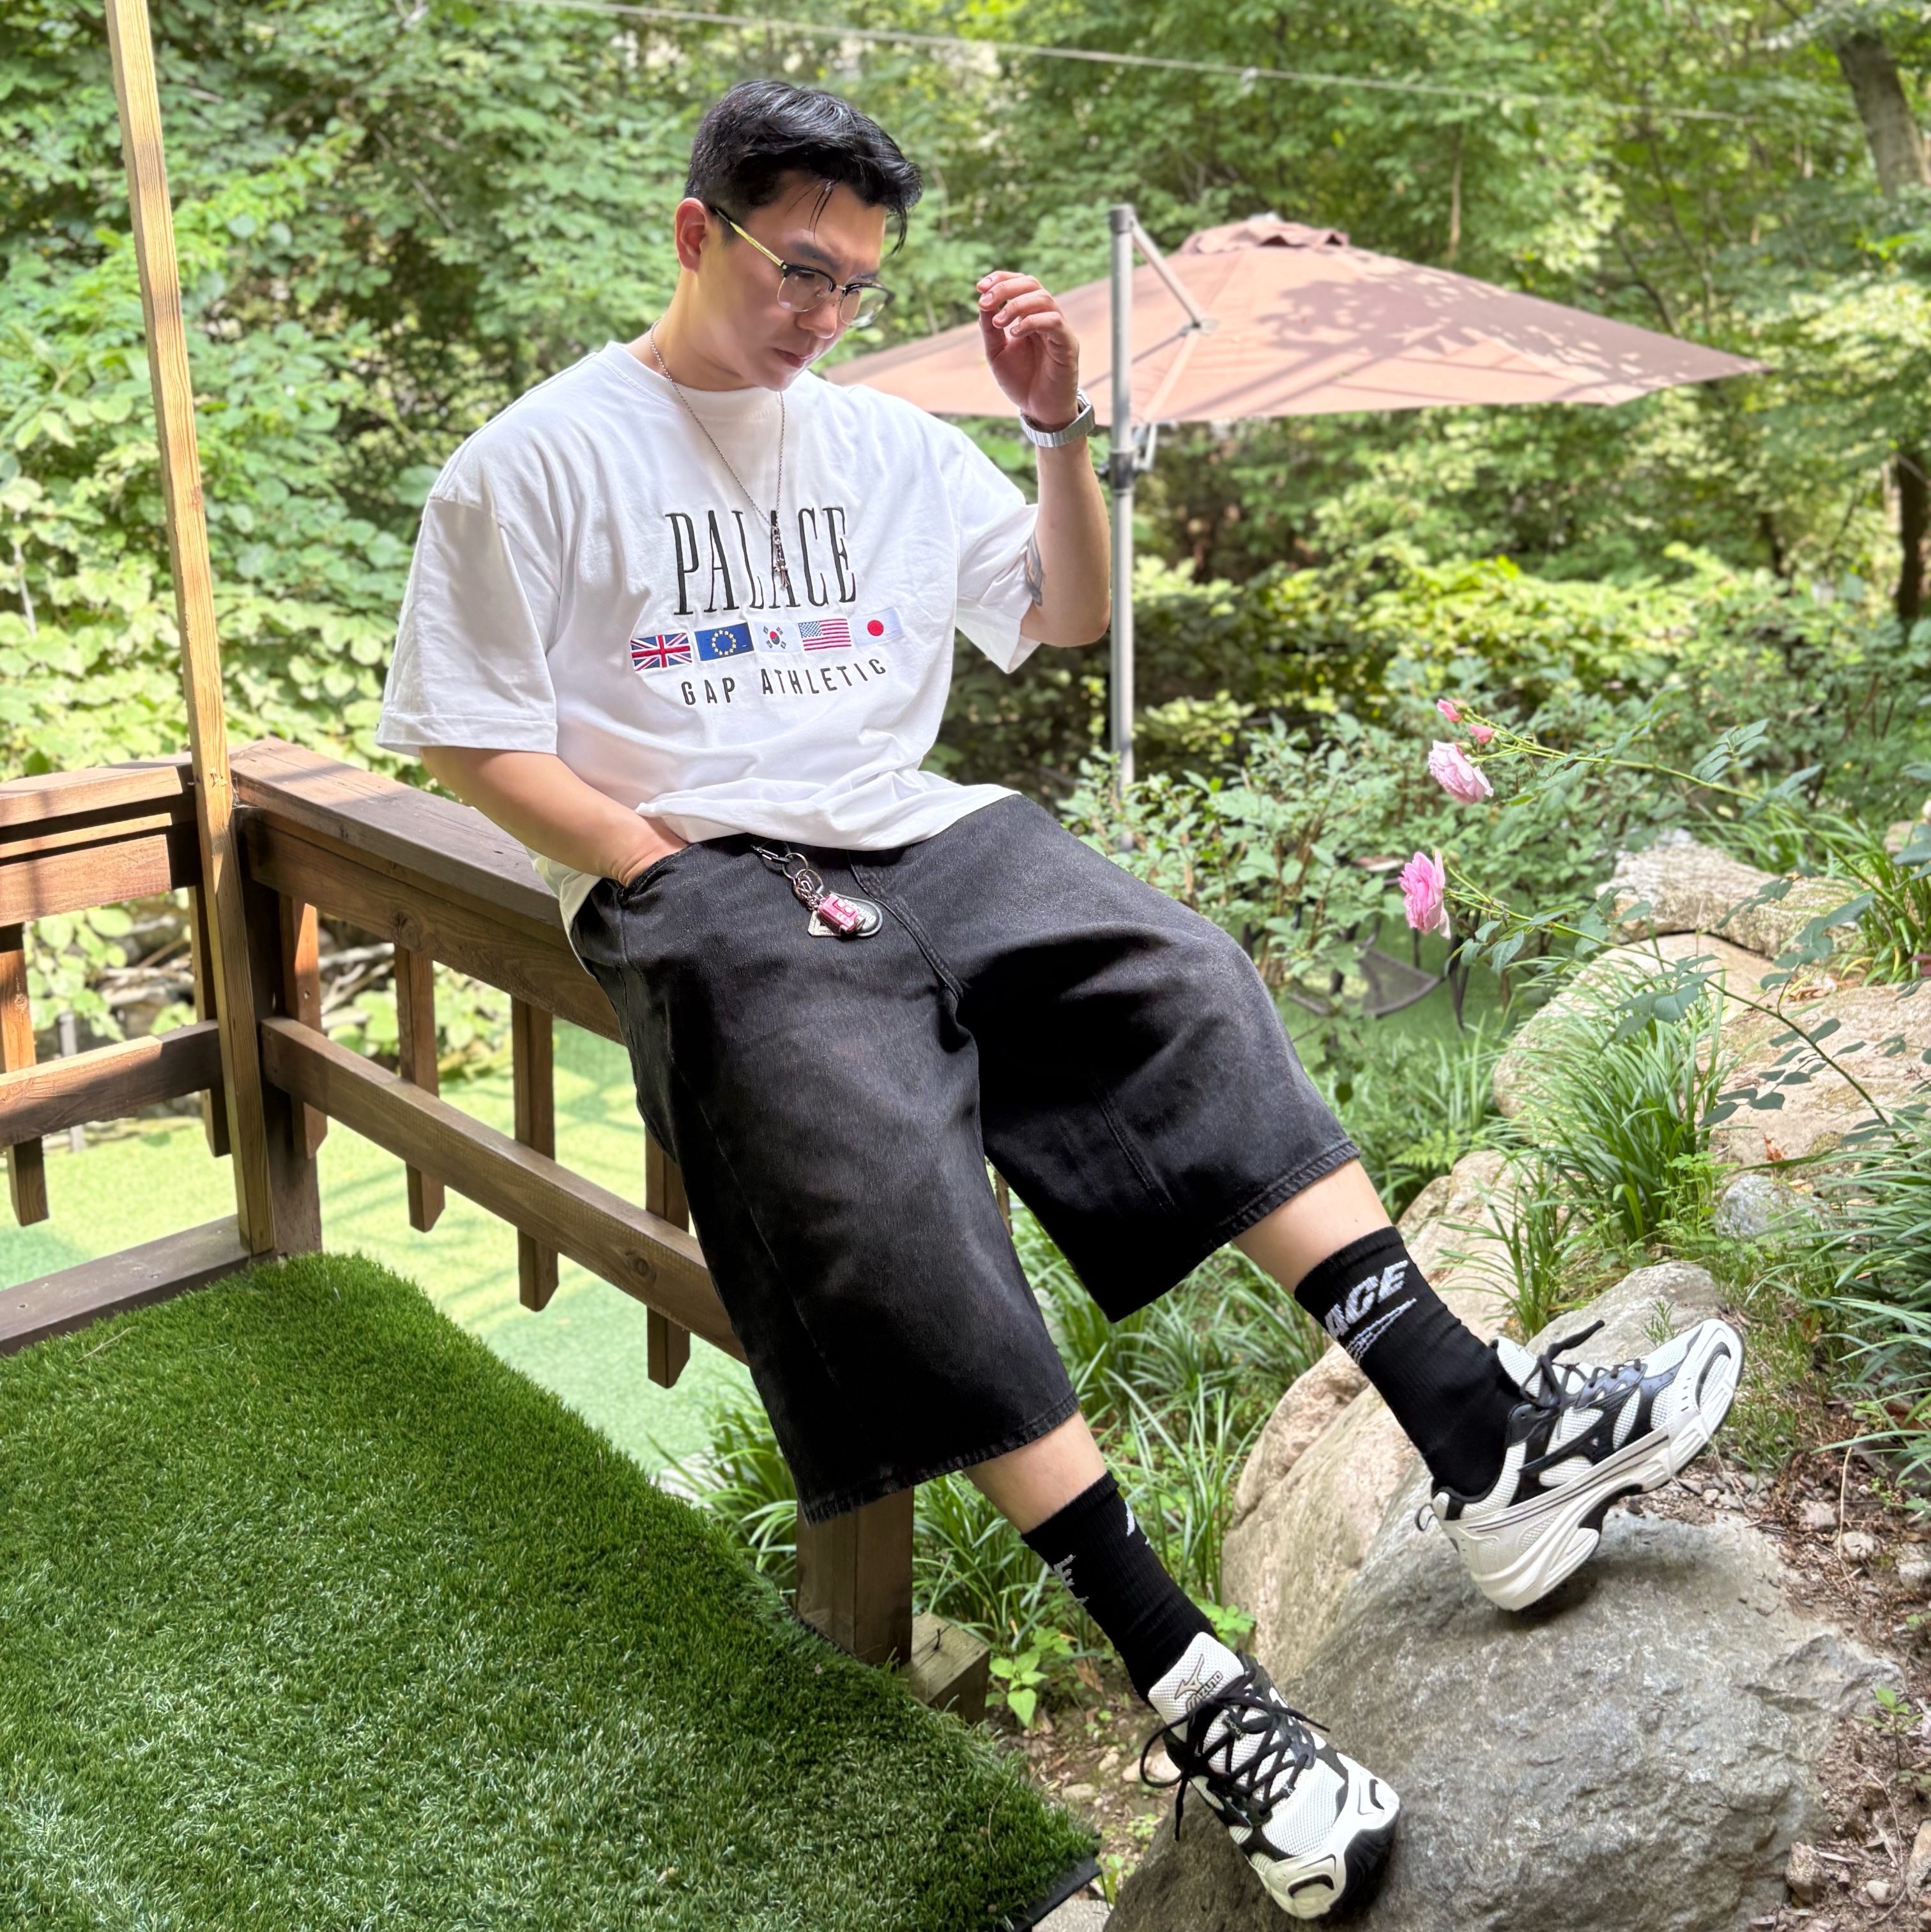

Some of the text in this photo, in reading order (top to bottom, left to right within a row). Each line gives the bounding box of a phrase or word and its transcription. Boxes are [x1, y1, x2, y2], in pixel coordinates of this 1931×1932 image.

[665, 506, 857, 616] PALACE
[681, 658, 886, 706] GAP ATHLETIC
